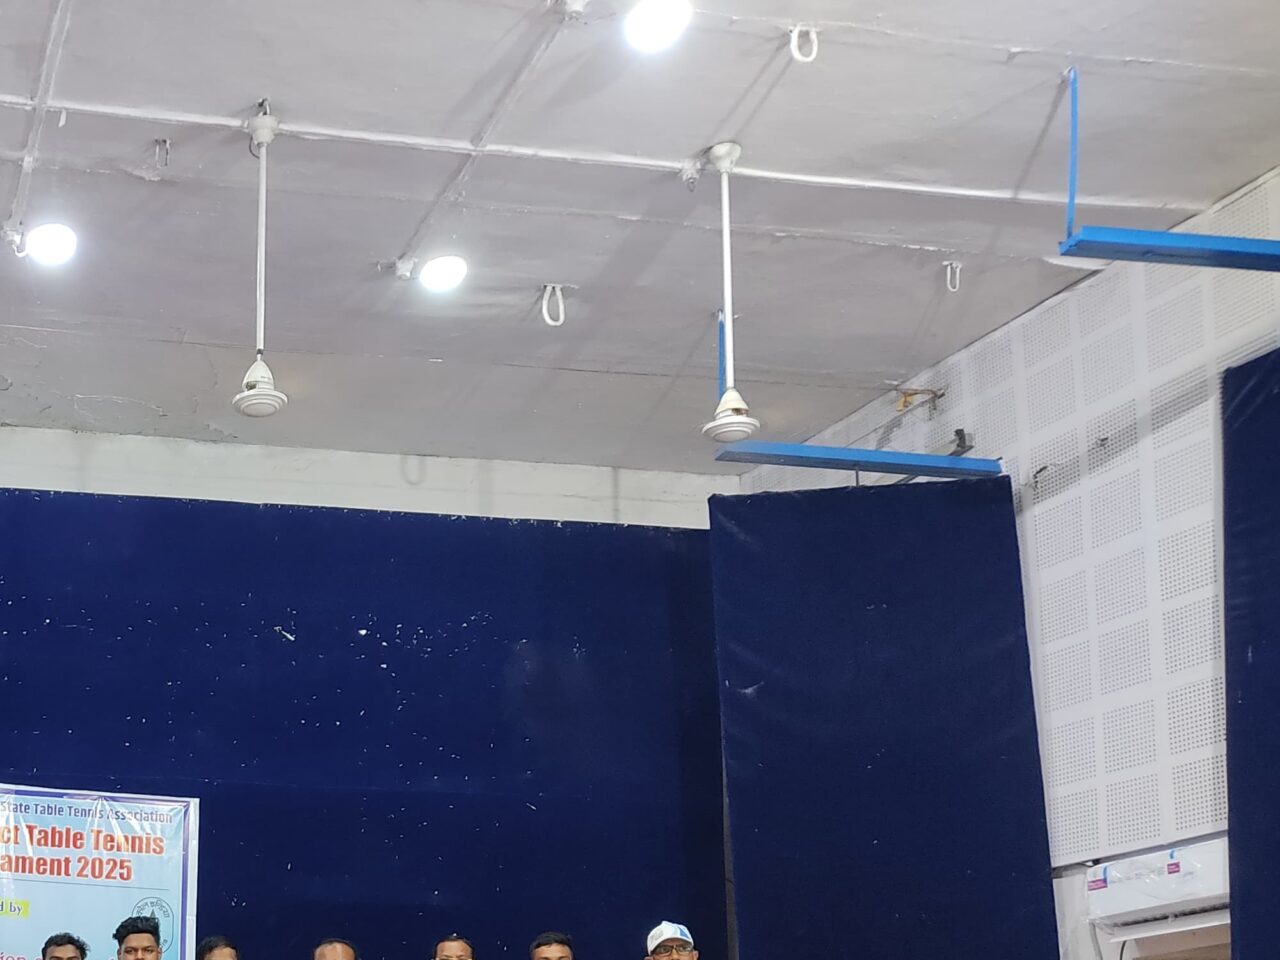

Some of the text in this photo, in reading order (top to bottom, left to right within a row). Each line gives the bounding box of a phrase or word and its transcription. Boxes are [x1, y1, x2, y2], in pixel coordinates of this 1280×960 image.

[33, 803, 64, 816] Table
[67, 805, 104, 819] Tennis
[107, 808, 173, 824] Association
[25, 824, 85, 849] Table
[91, 829, 165, 854] Tennis
[76, 856, 133, 880] 2025
[9, 901, 23, 915] by
